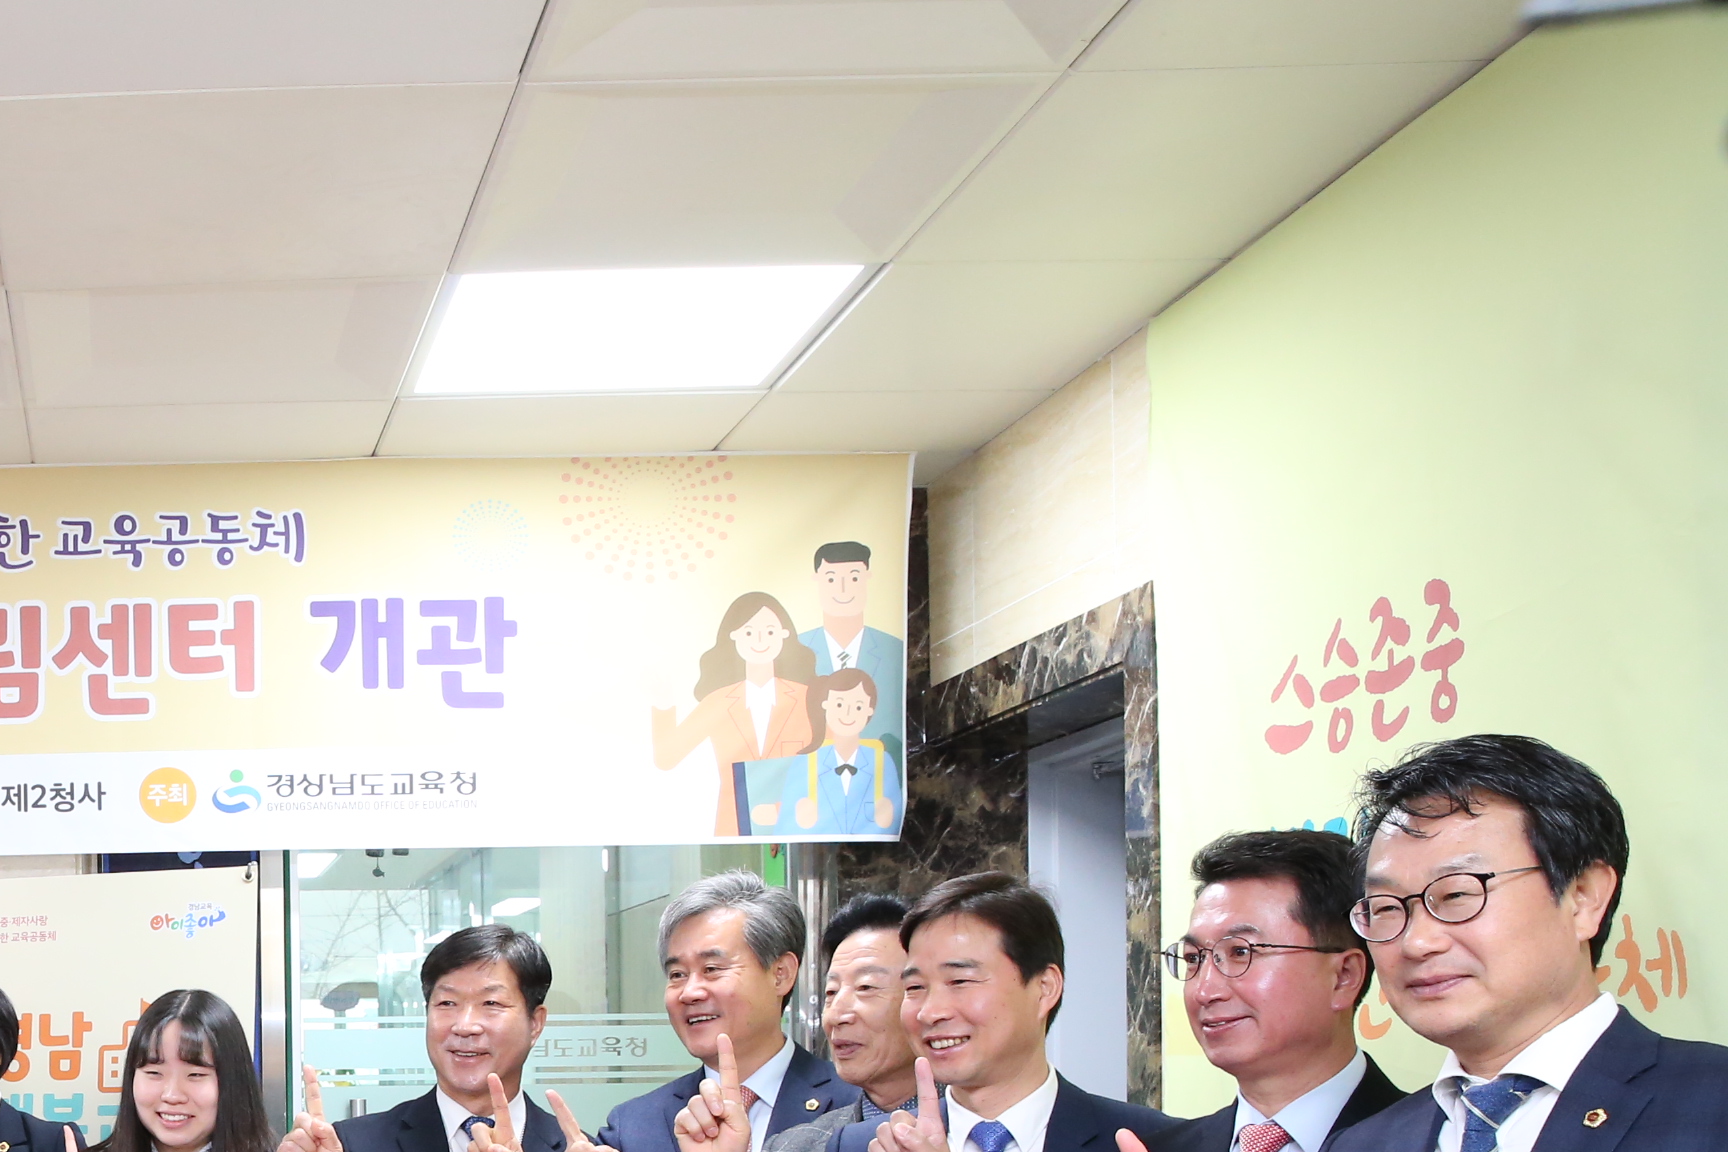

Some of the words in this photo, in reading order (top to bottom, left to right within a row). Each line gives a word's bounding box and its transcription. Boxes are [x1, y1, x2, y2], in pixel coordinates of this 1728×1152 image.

[53, 508, 306, 571] 교육공동체
[308, 595, 518, 711] 개관
[1264, 578, 1465, 754] 스승존중
[1, 782, 106, 813] 제2청사
[147, 782, 189, 808] 주최
[266, 770, 478, 798] 경상남도교육청
[266, 801, 371, 812] GYEONGSANGNAMDO
[373, 800, 405, 811] OFFICE
[408, 801, 420, 811] OF
[422, 799, 478, 810] EDUCATION
[187, 902, 213, 911] 경남교육
[10, 930, 57, 943] 교육공동체
[150, 909, 227, 939] 아이좋아
